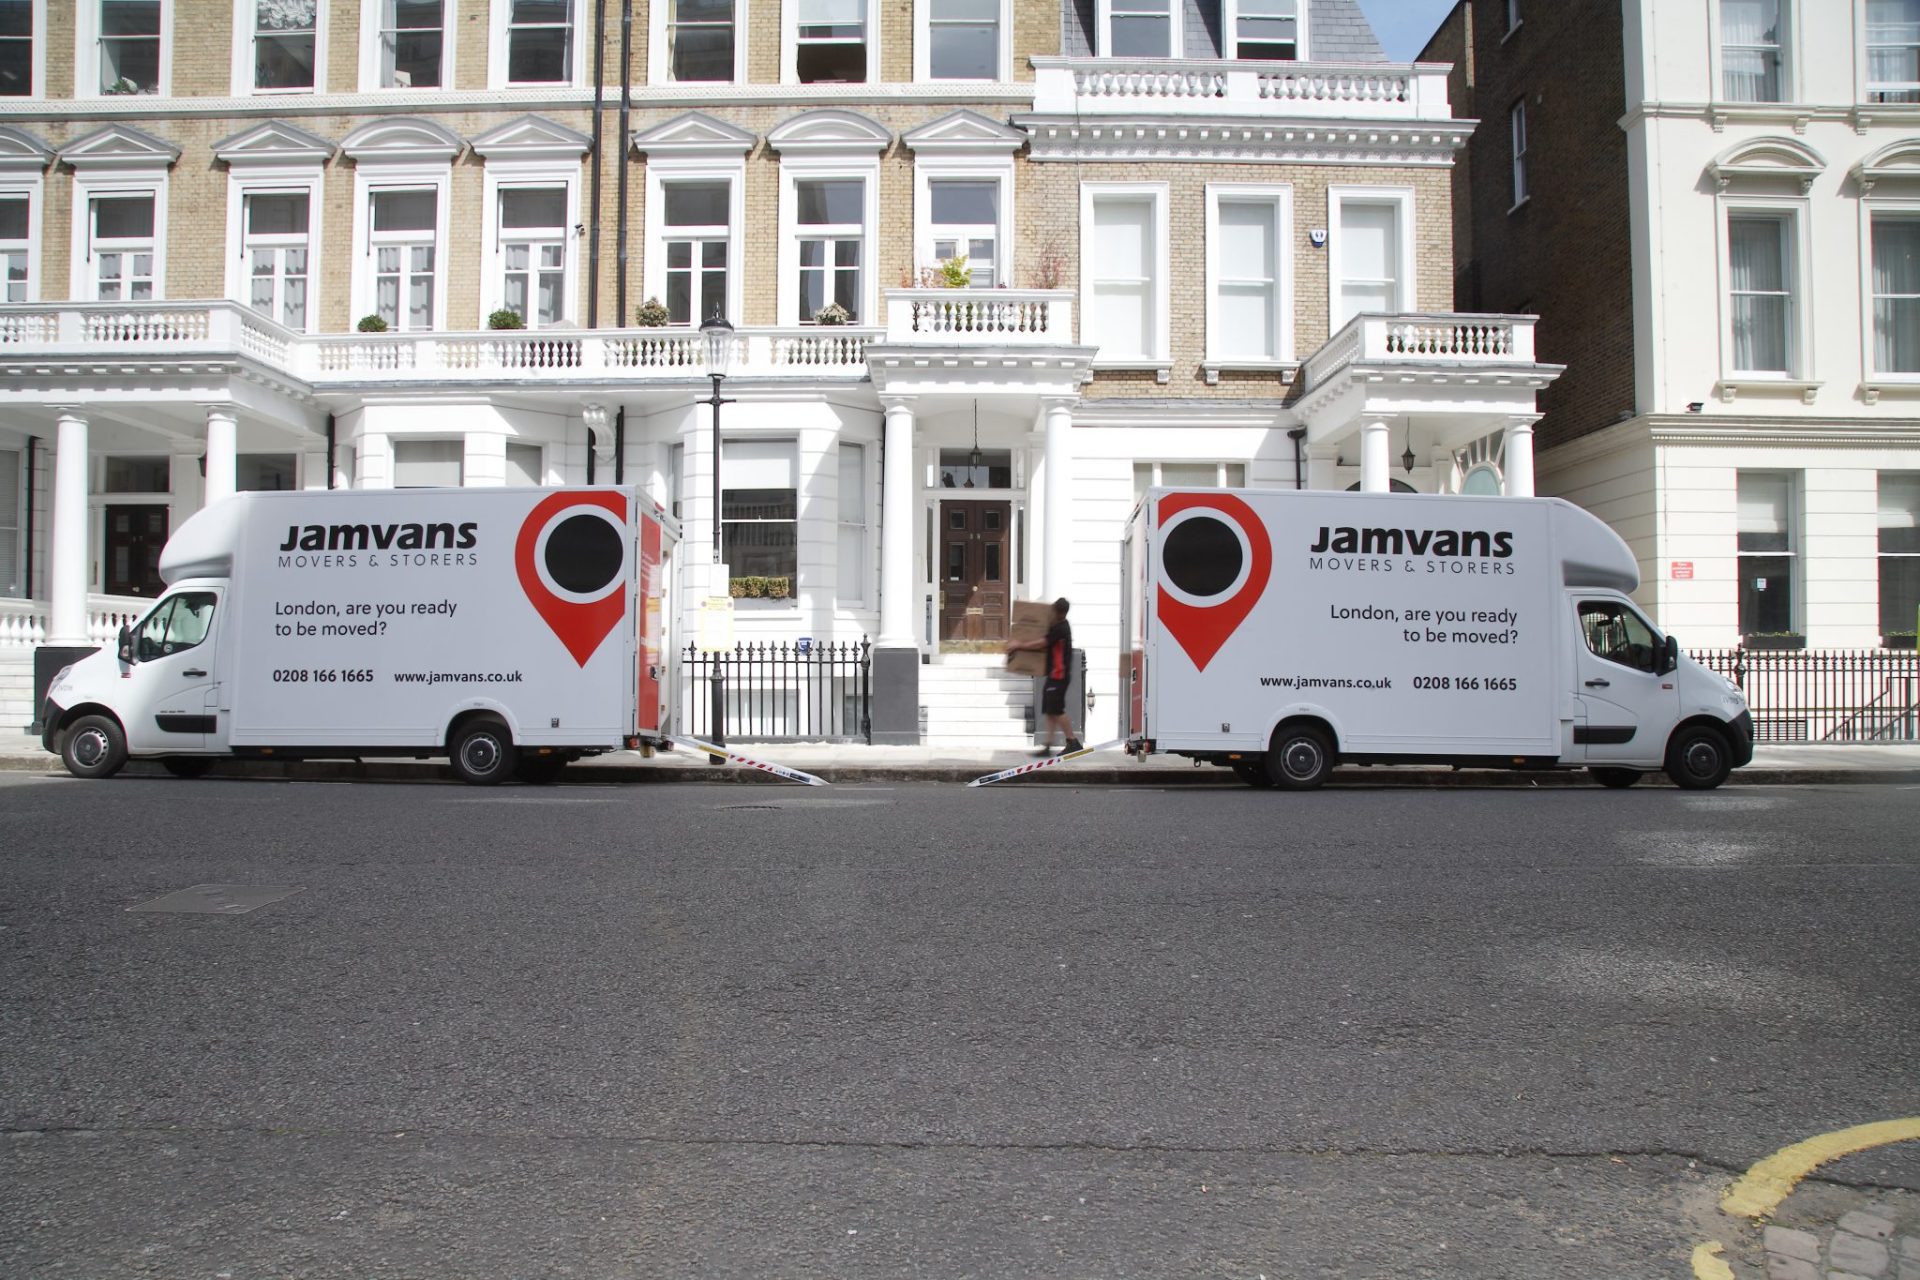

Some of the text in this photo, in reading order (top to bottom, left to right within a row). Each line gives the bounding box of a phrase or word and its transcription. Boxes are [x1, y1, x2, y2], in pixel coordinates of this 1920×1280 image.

[280, 522, 478, 551] Jamvans
[1310, 526, 1514, 557] Jamvans
[277, 552, 478, 569] MOVERS & STORERS
[1309, 557, 1515, 575] MOVERS & STORERS
[275, 599, 457, 619] London, are you ready
[1331, 604, 1517, 626] London, are you ready
[275, 619, 388, 637] to be moved?
[1403, 626, 1518, 644] to be moved?
[273, 669, 374, 683] 0208 166 1665
[394, 670, 522, 685] www.jamvans.co.uk
[1260, 676, 1392, 689] www.jamvans.co.uk
[1413, 676, 1518, 692] 0208 166 1665
